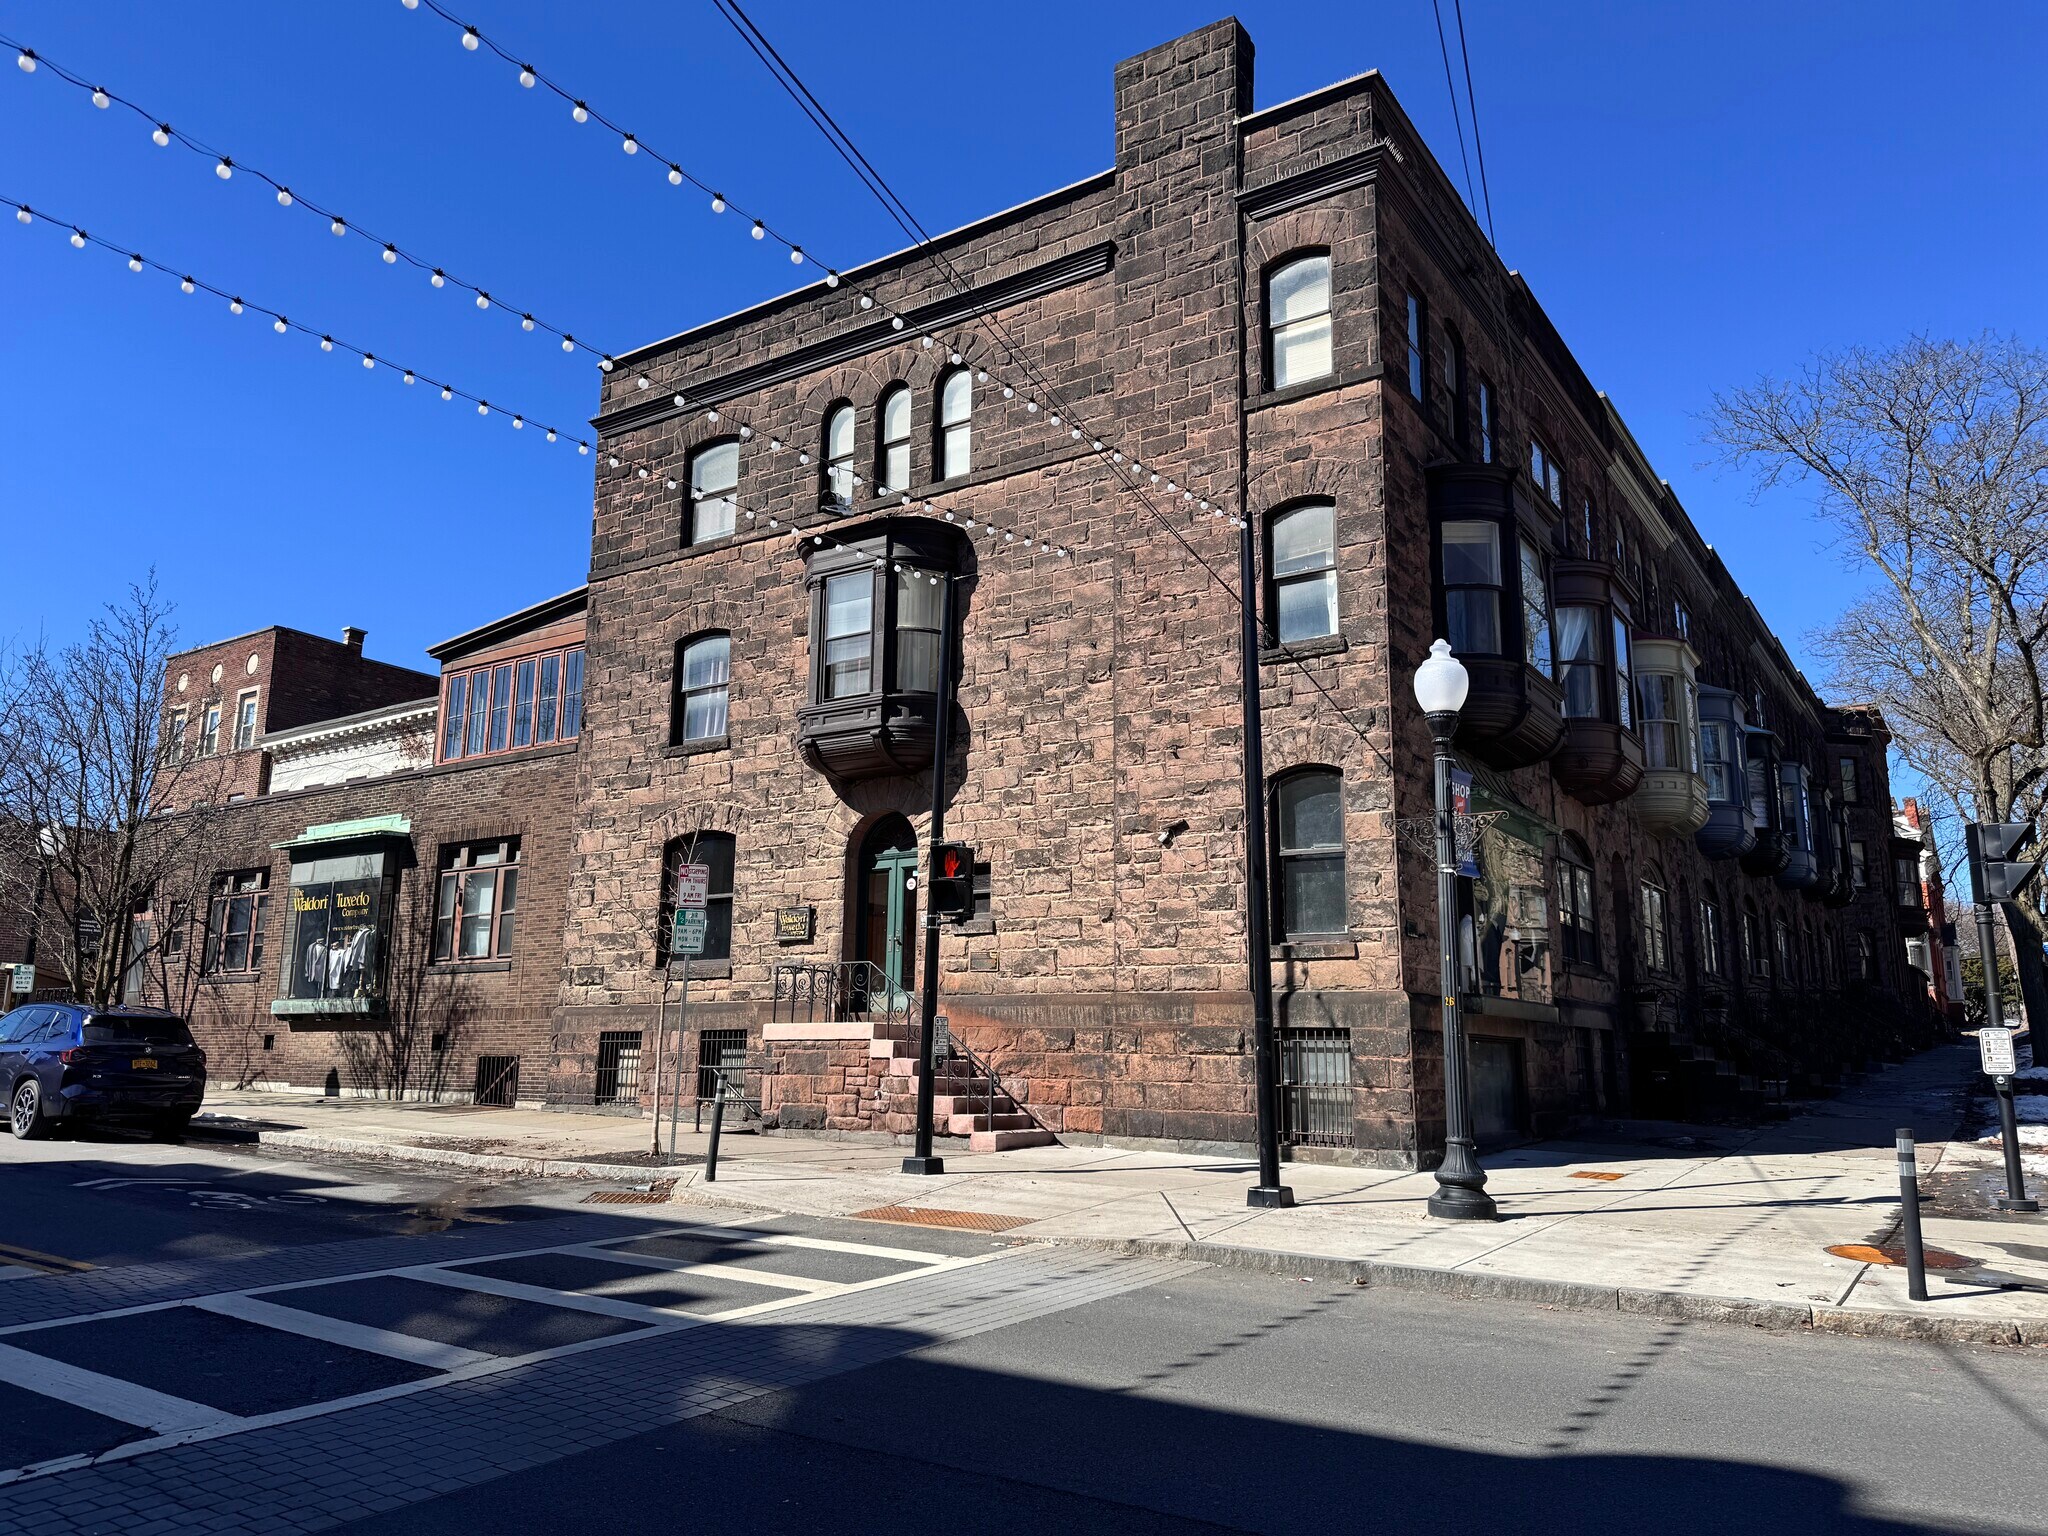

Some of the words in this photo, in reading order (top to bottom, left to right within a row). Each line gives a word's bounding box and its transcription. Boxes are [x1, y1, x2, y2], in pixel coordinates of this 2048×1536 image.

[1452, 782, 1470, 798] SHOP
[680, 867, 688, 876] NO
[688, 868, 707, 876] STOPPING
[294, 888, 304, 897] The
[293, 894, 329, 912] Waldorf
[336, 891, 370, 908] Tuxedo
